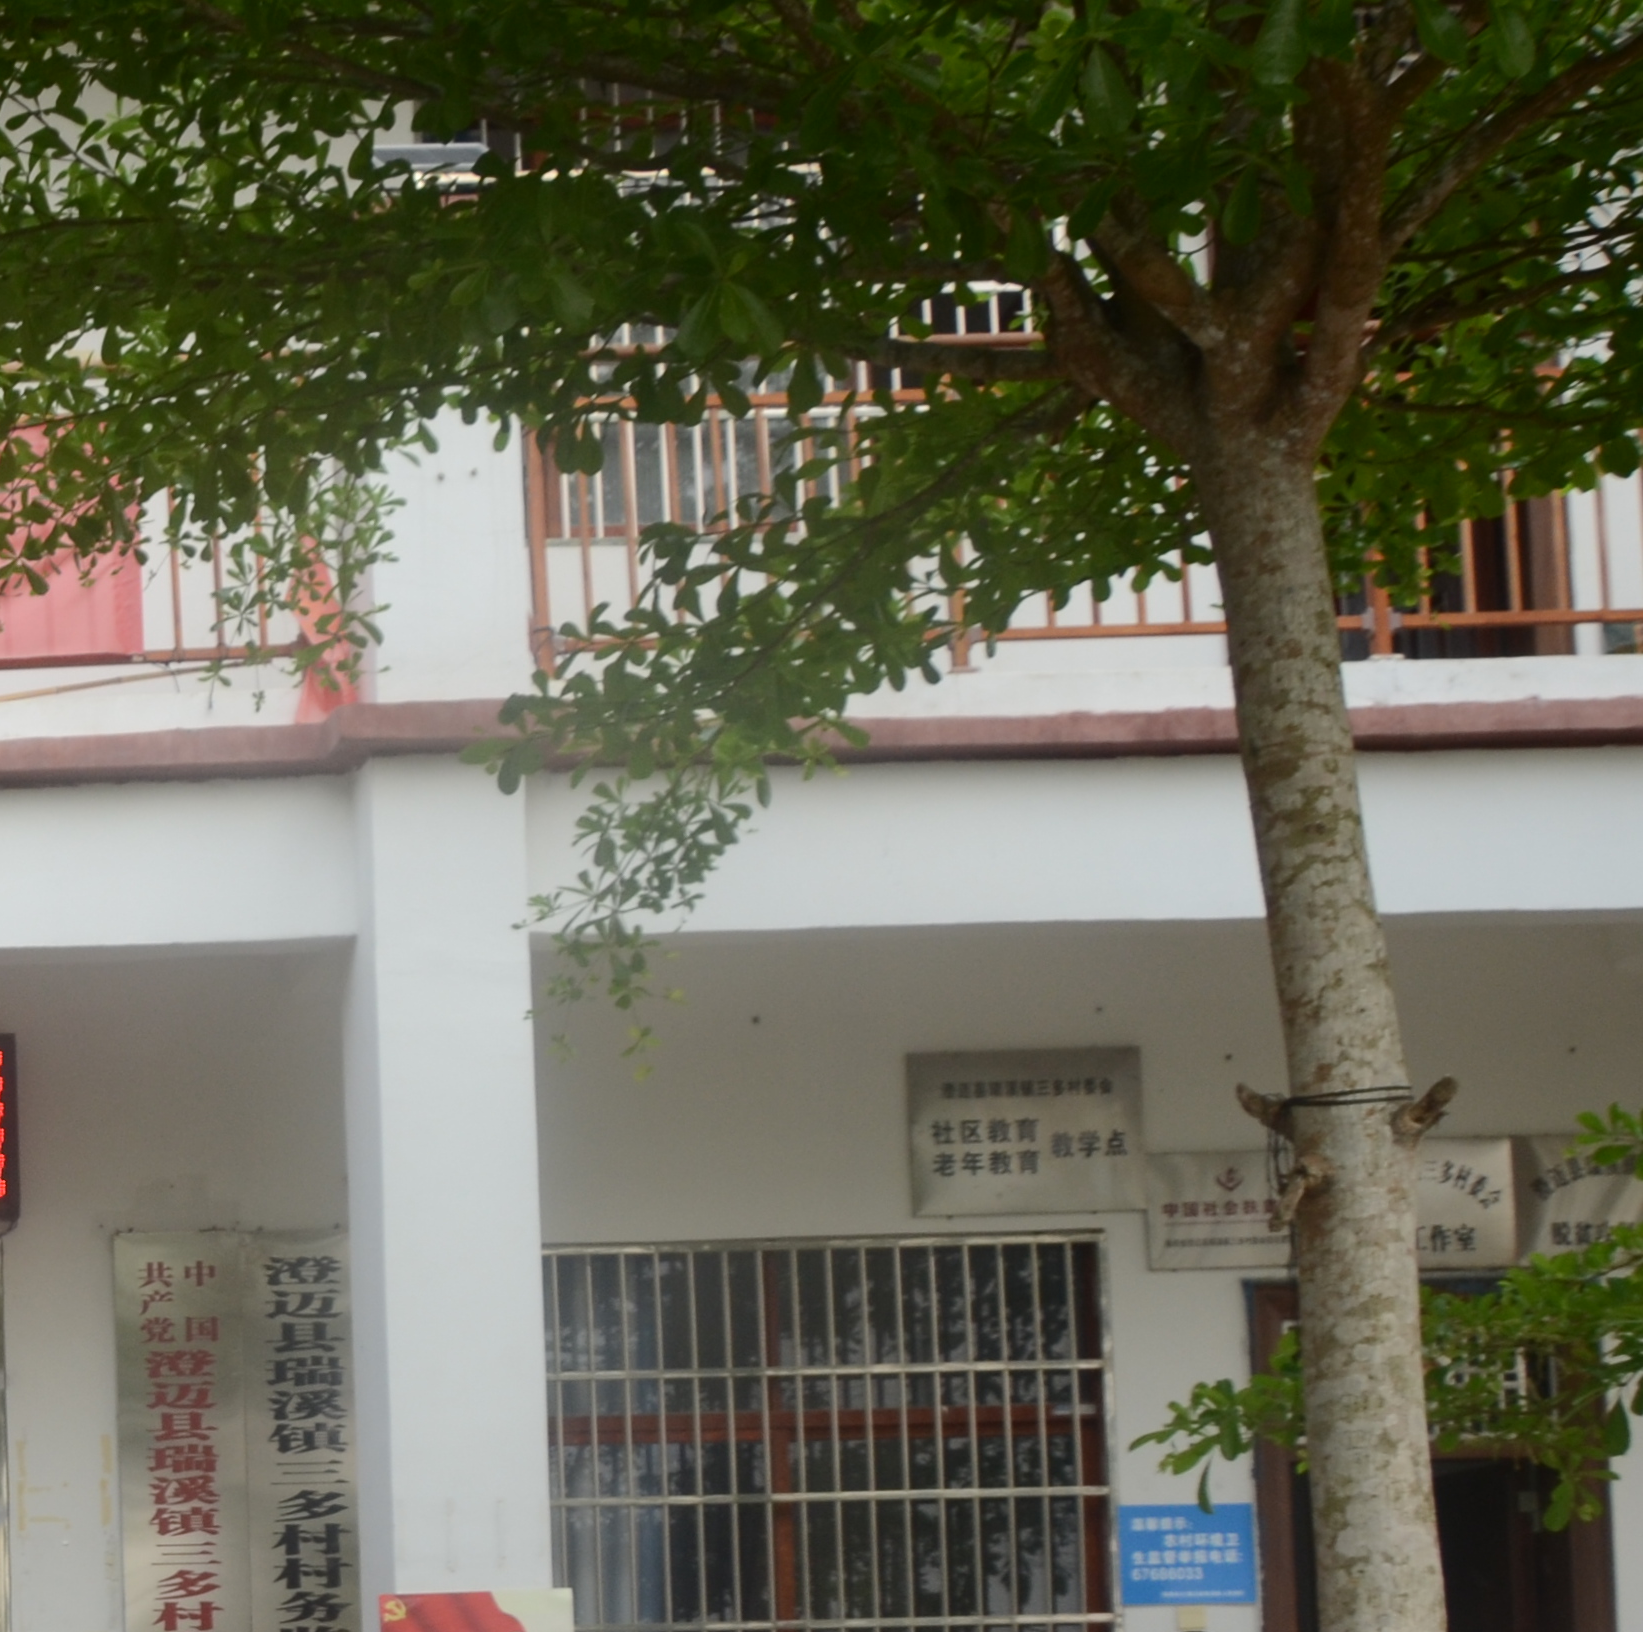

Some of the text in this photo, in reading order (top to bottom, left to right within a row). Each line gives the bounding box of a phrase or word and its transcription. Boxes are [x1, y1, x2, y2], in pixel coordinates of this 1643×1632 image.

[932, 1118, 1127, 1158] 社区教育 教学点
[933, 1150, 1039, 1178] 老年教育
